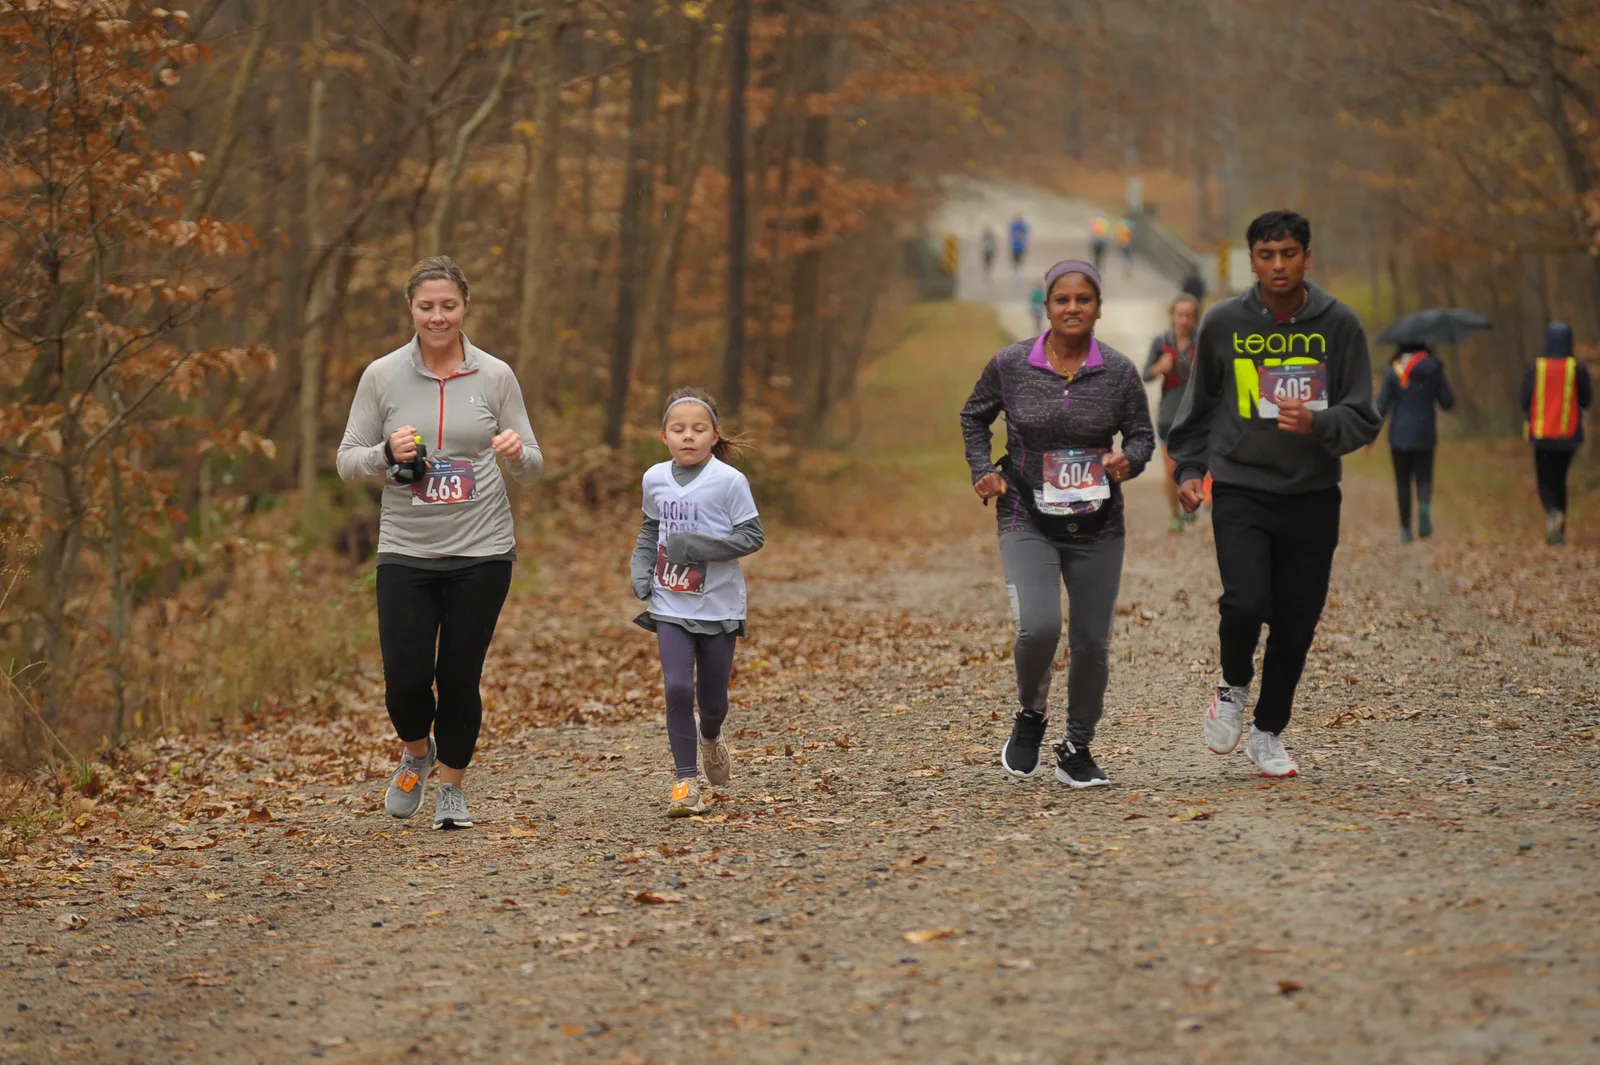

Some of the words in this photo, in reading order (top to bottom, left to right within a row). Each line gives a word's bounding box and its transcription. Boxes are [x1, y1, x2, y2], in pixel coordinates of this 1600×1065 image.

[1233, 331, 1326, 354] team
[1273, 377, 1312, 400] 605
[1058, 461, 1094, 488] 604
[426, 474, 463, 500] 463
[663, 500, 700, 521] DON'T
[662, 562, 690, 590] 464
